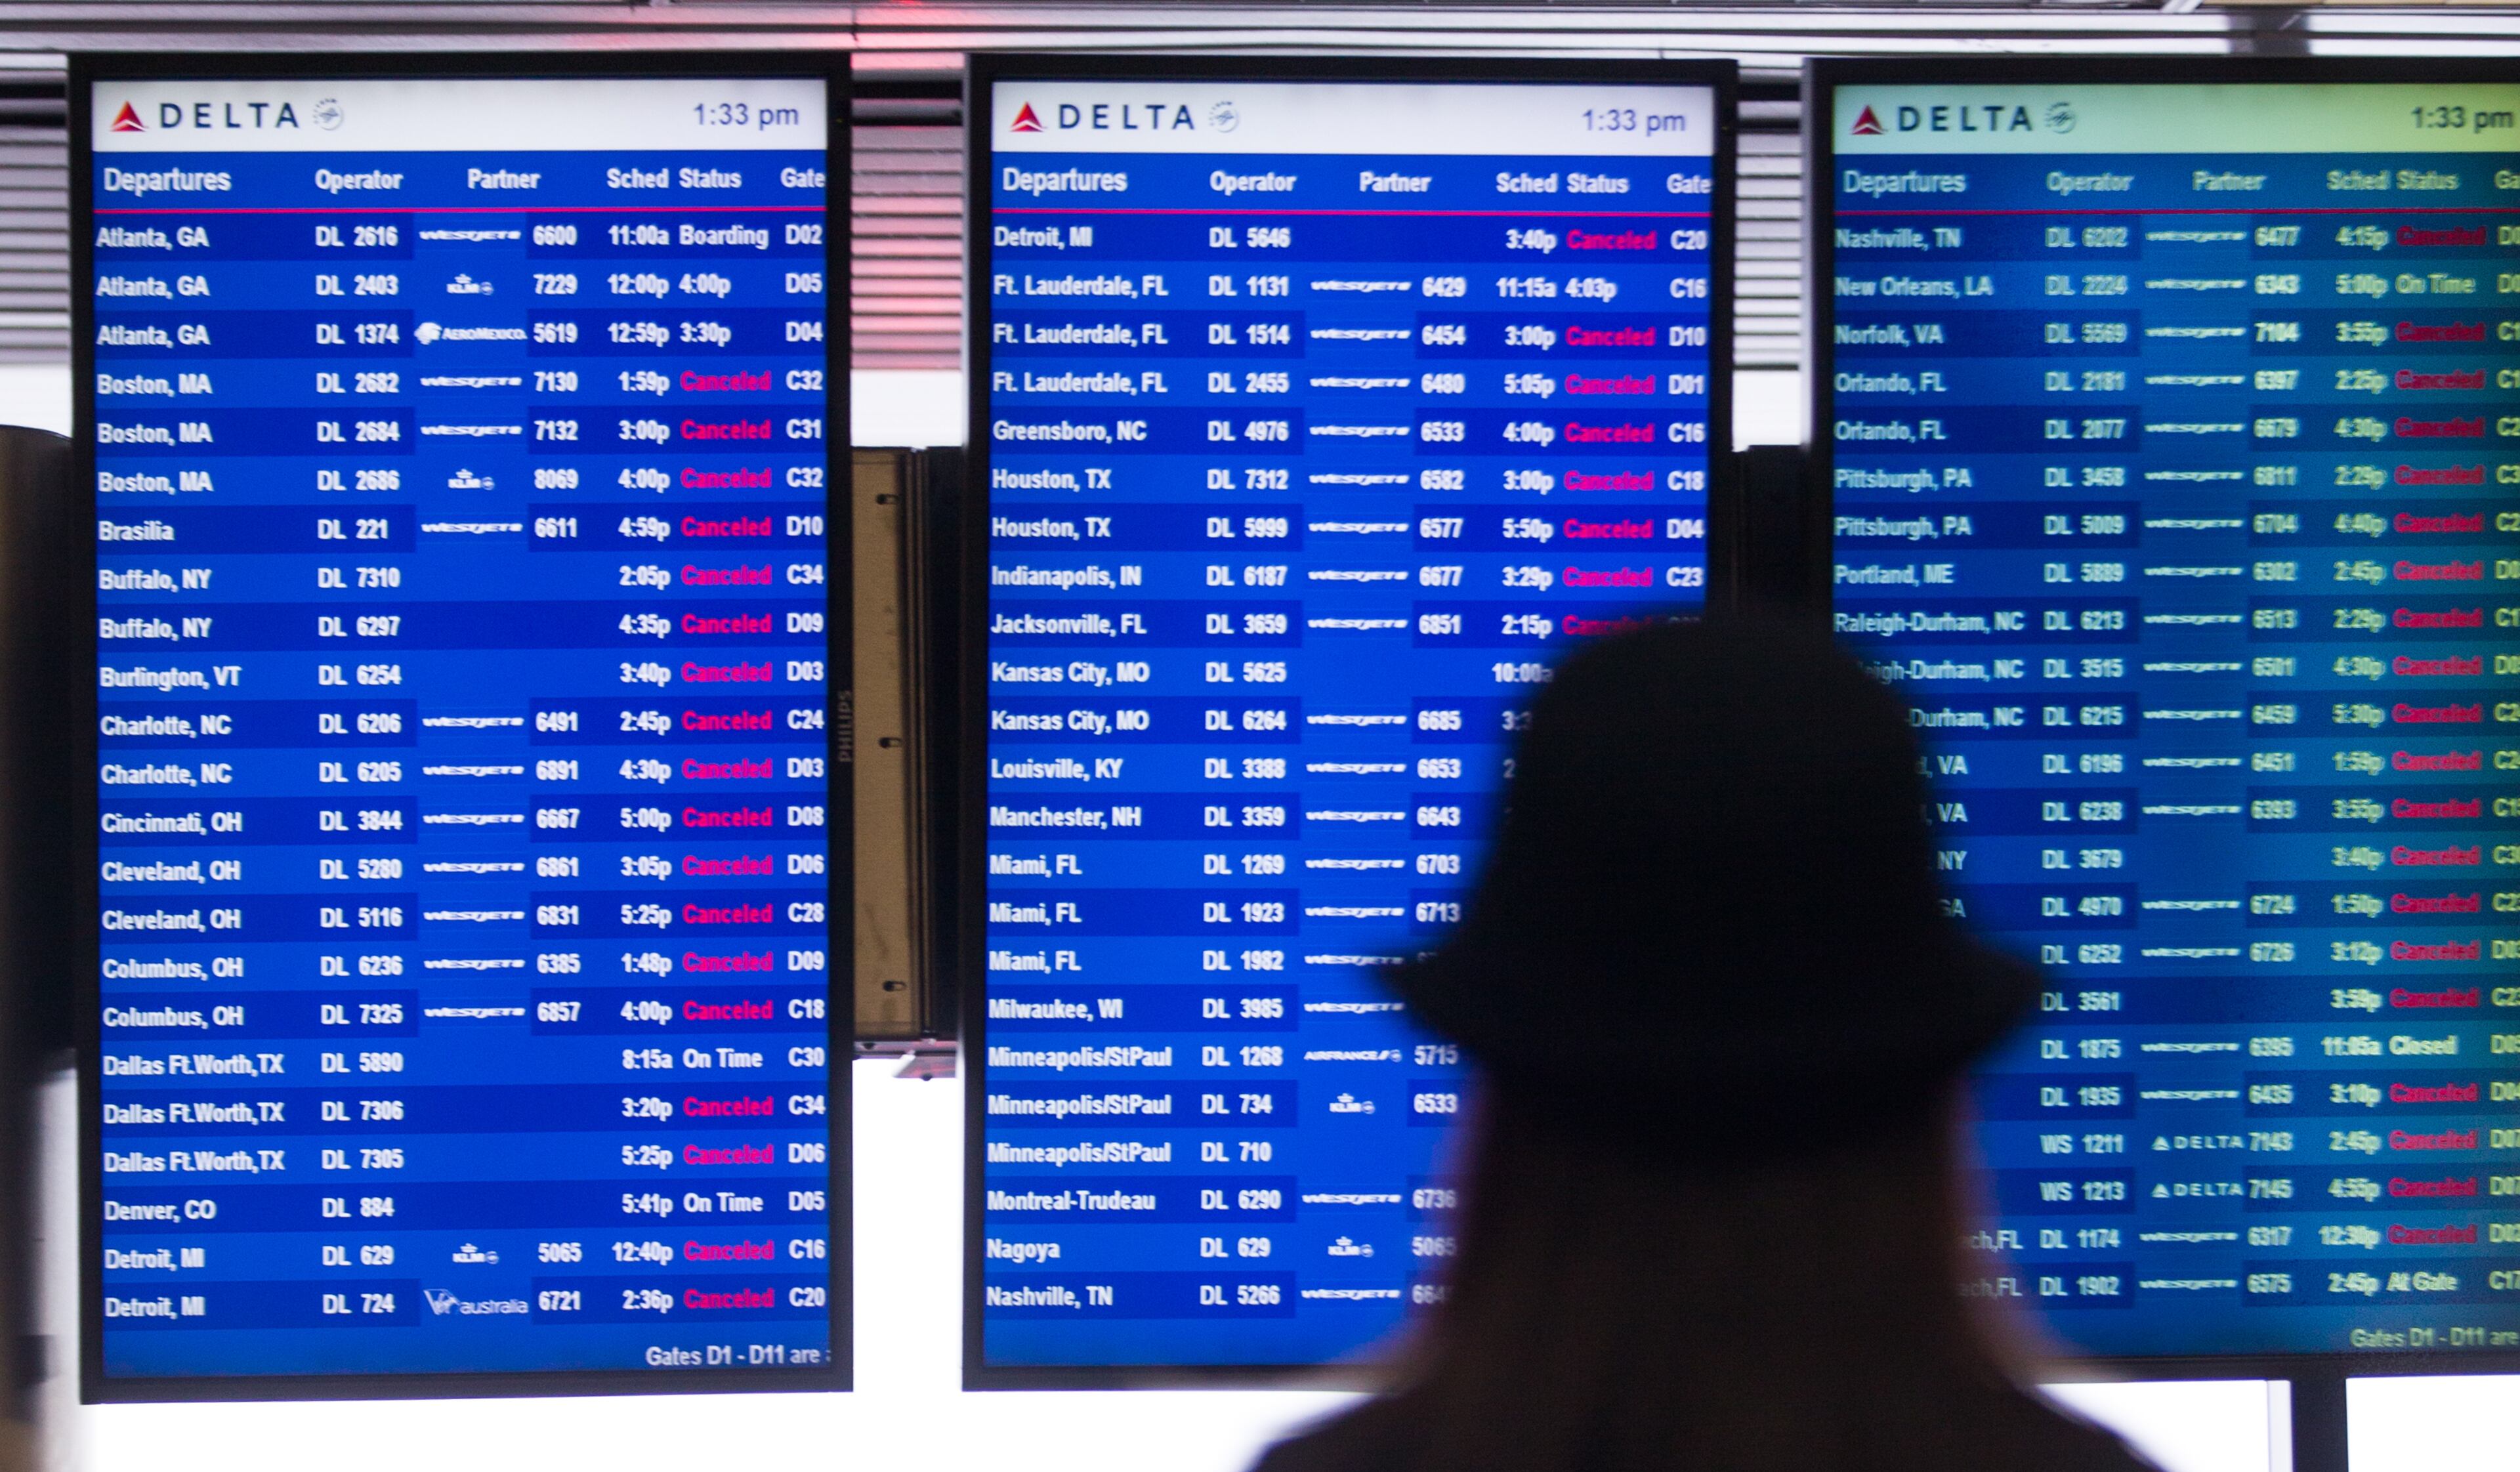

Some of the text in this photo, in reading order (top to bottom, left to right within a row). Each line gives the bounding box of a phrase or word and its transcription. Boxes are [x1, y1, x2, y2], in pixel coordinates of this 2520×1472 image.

[160, 102, 297, 128] DELTA
[695, 103, 798, 130] 1:33 pm
[1060, 104, 1193, 129] DELTA
[1584, 109, 1685, 135] 1:33 pm
[1899, 106, 2031, 131] DELTA
[2413, 106, 2514, 133] 1:33 pm
[105, 168, 825, 196] Departures Operator Partner Sched Status Gate
[1003, 167, 1711, 196] Departures Operator Partner Sched Status Gate
[1845, 170, 2520, 197] Departures Operator Partner Sched Status Ga
[96, 228, 171, 249] Atlanta,
[177, 227, 209, 247] GA
[316, 226, 344, 246] DL
[354, 226, 398, 246] 2616
[534, 226, 577, 245] 6600
[609, 225, 669, 245] 11:00a
[680, 224, 768, 249] Boarding
[786, 224, 822, 244] D02
[995, 226, 1707, 253] Detroit, MI DL 5646 3:40p Canceled C20
[994, 275, 1018, 295] Ft.
[1025, 276, 1137, 298] Lauderdale,
[1143, 275, 1168, 295] FL
[1209, 276, 1236, 296] DL
[1247, 276, 1288, 296] 1131
[1423, 277, 1466, 297] 6429
[1497, 278, 1557, 297] 11:15a
[1565, 278, 1616, 302] 4:03p
[1670, 278, 1706, 298] C16
[1835, 277, 1876, 295] New
[1882, 277, 1958, 297] Orleans,
[1966, 276, 1992, 295] LA
[2046, 276, 2074, 295] DL
[2396, 274, 2426, 294] On
[2428, 274, 2475, 293] Time
[97, 326, 173, 347] Atlanta,
[178, 325, 209, 345] GA
[317, 324, 345, 344] DL
[355, 324, 399, 343] 1374
[534, 323, 578, 343] 5619
[608, 322, 669, 347] 12:59p
[681, 322, 730, 347] 3:30p
[786, 322, 823, 341] D04
[993, 469, 1080, 492] Houston,
[1085, 469, 1111, 488] TX
[1208, 469, 1235, 489] DL
[1246, 469, 1288, 490] 7312
[1421, 470, 1464, 490] 6582
[1504, 471, 1554, 495] 3:00p
[1564, 471, 1654, 490] Canceled
[1668, 471, 1704, 490] C18
[99, 521, 173, 540] Brasilia
[318, 519, 346, 539] DL
[356, 519, 387, 539] 221
[535, 518, 576, 537] 6611
[619, 517, 670, 541] 4:59p
[681, 516, 771, 537] Canceled
[787, 516, 823, 536] D10
[1836, 612, 1989, 636] Raleigh-Durham,
[1996, 612, 2023, 630] NC
[2045, 611, 2071, 630] DL
[2393, 608, 2482, 628] Canceled
[100, 662, 824, 692] Burlington, VT DL 6254 3:40p Canceled D03
[992, 662, 1553, 686] Kansas City, MO DL 5625 10:00a
[838, 690, 852, 762] PHILIPS
[102, 812, 206, 835] Cincinnati,
[211, 812, 242, 831] OH
[320, 811, 348, 831] DL
[358, 810, 402, 830] 3844
[537, 809, 579, 828] 6667
[621, 808, 671, 832] 5:00p
[682, 807, 772, 827] Canceled
[788, 807, 824, 826] D08
[987, 1046, 1172, 1072] Minneapolis/StPaul
[1202, 1046, 1230, 1066] DL
[1240, 1046, 1283, 1066] 1268
[1415, 1045, 1456, 1065] 5715
[2042, 1040, 2068, 1059] DL
[2389, 1036, 2458, 1055] Closed
[104, 1047, 824, 1076] Dallas Ft.Worth,TX DL 5890 8:15a On Time C30
[2041, 1135, 2072, 1153] WS
[2174, 1135, 2244, 1149] DELTA
[2389, 1129, 2478, 1150] Canceled
[986, 1238, 1060, 1261] Nagoya
[1201, 1238, 1228, 1257] DL
[1238, 1238, 1270, 1257] 629
[1412, 1236, 1457, 1257] 5065
[106, 1297, 177, 1319] Detroit,
[182, 1297, 204, 1315] MI
[323, 1294, 350, 1314] DL
[361, 1293, 394, 1313] 724
[459, 1299, 529, 1314] australia
[539, 1291, 580, 1311] 6721
[623, 1290, 673, 1313] 2:36p
[684, 1288, 774, 1309] Canceled
[789, 1288, 826, 1307] C20
[645, 1346, 702, 1366] Gates
[707, 1345, 732, 1365] D1
[749, 1344, 785, 1364] D11
[789, 1349, 820, 1364] are
